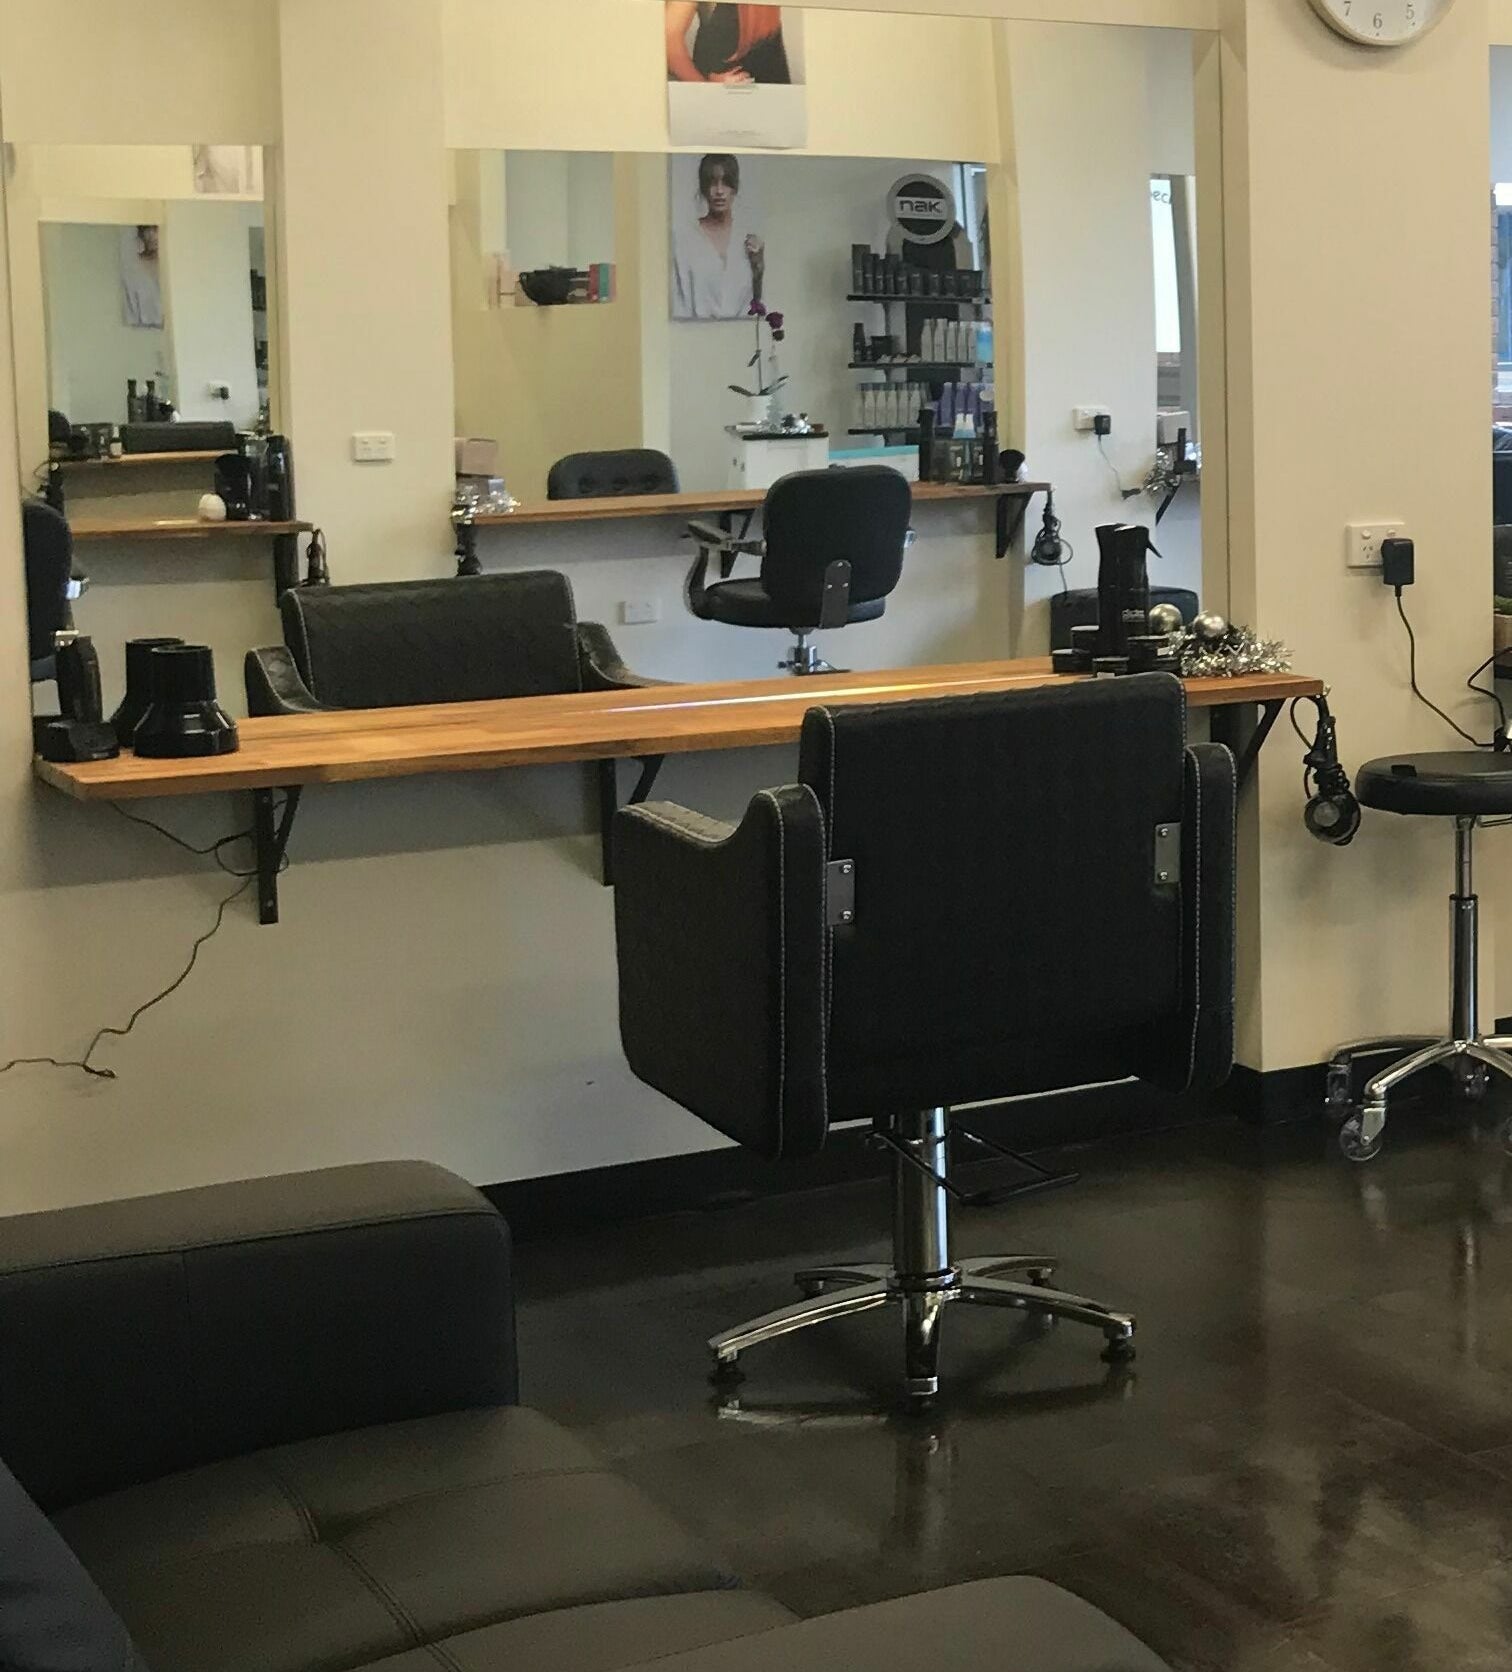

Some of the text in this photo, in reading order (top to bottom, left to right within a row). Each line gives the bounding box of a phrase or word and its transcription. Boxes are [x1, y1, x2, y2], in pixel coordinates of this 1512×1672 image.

[1344, 1, 1351, 16] 7
[1406, 3, 1416, 20] 5
[1373, 12, 1383, 29] 6
[900, 200, 942, 213] nak
